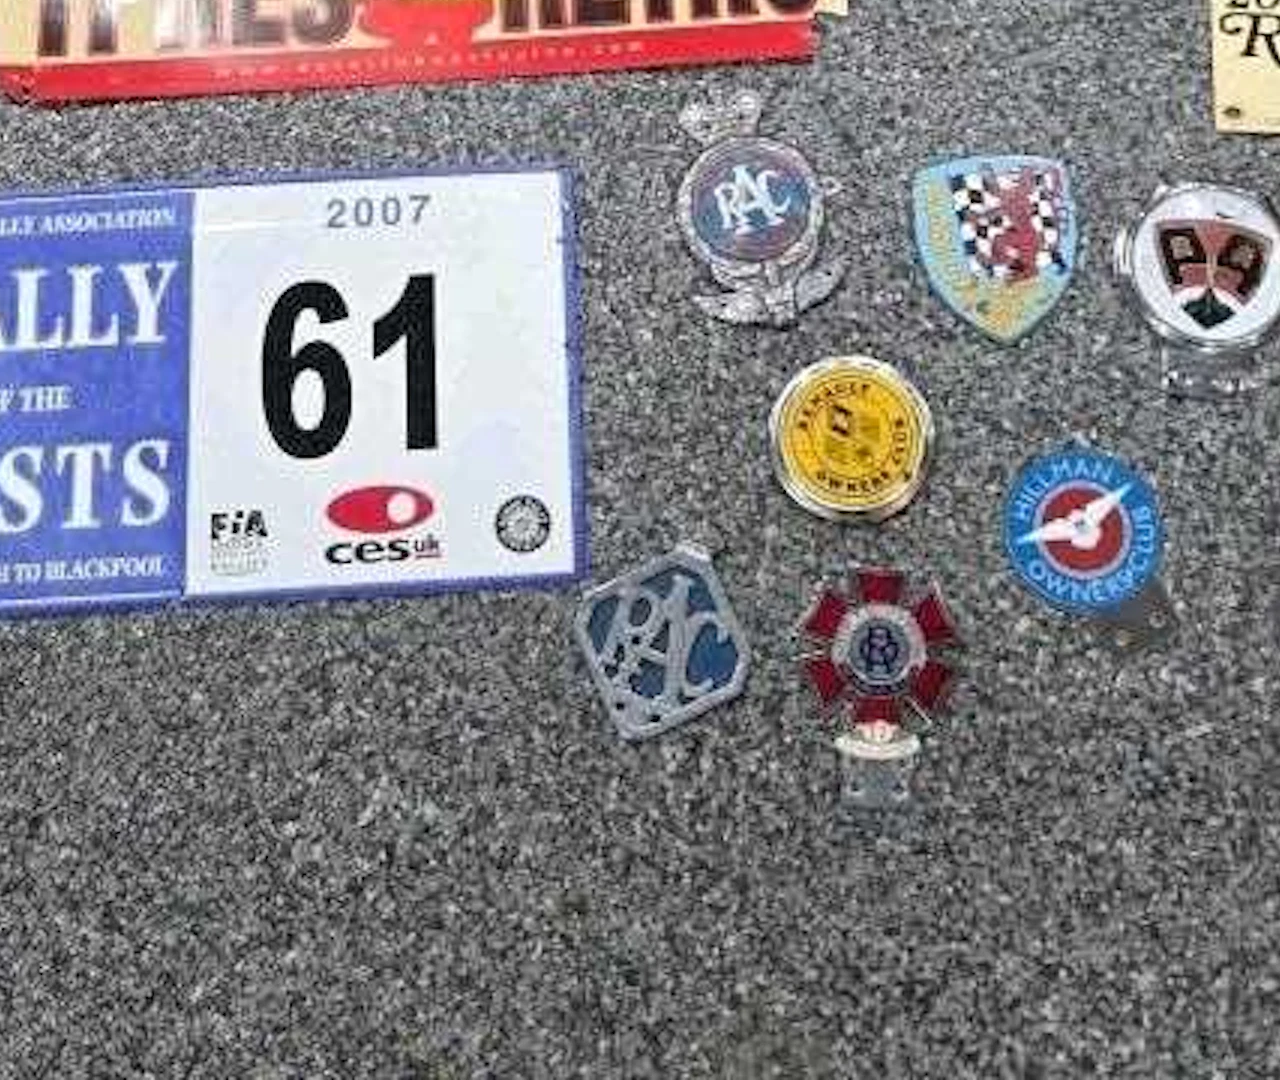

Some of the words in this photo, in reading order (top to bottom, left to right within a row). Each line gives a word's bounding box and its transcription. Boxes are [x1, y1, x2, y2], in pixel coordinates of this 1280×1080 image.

[38, 208, 175, 234] ASSOCIATION
[326, 196, 431, 228] 2007
[261, 274, 438, 459] 61
[19, 386, 70, 410] THE
[325, 539, 410, 564] ces
[14, 562, 41, 583] TO
[44, 557, 164, 580] BLACKPOOL
